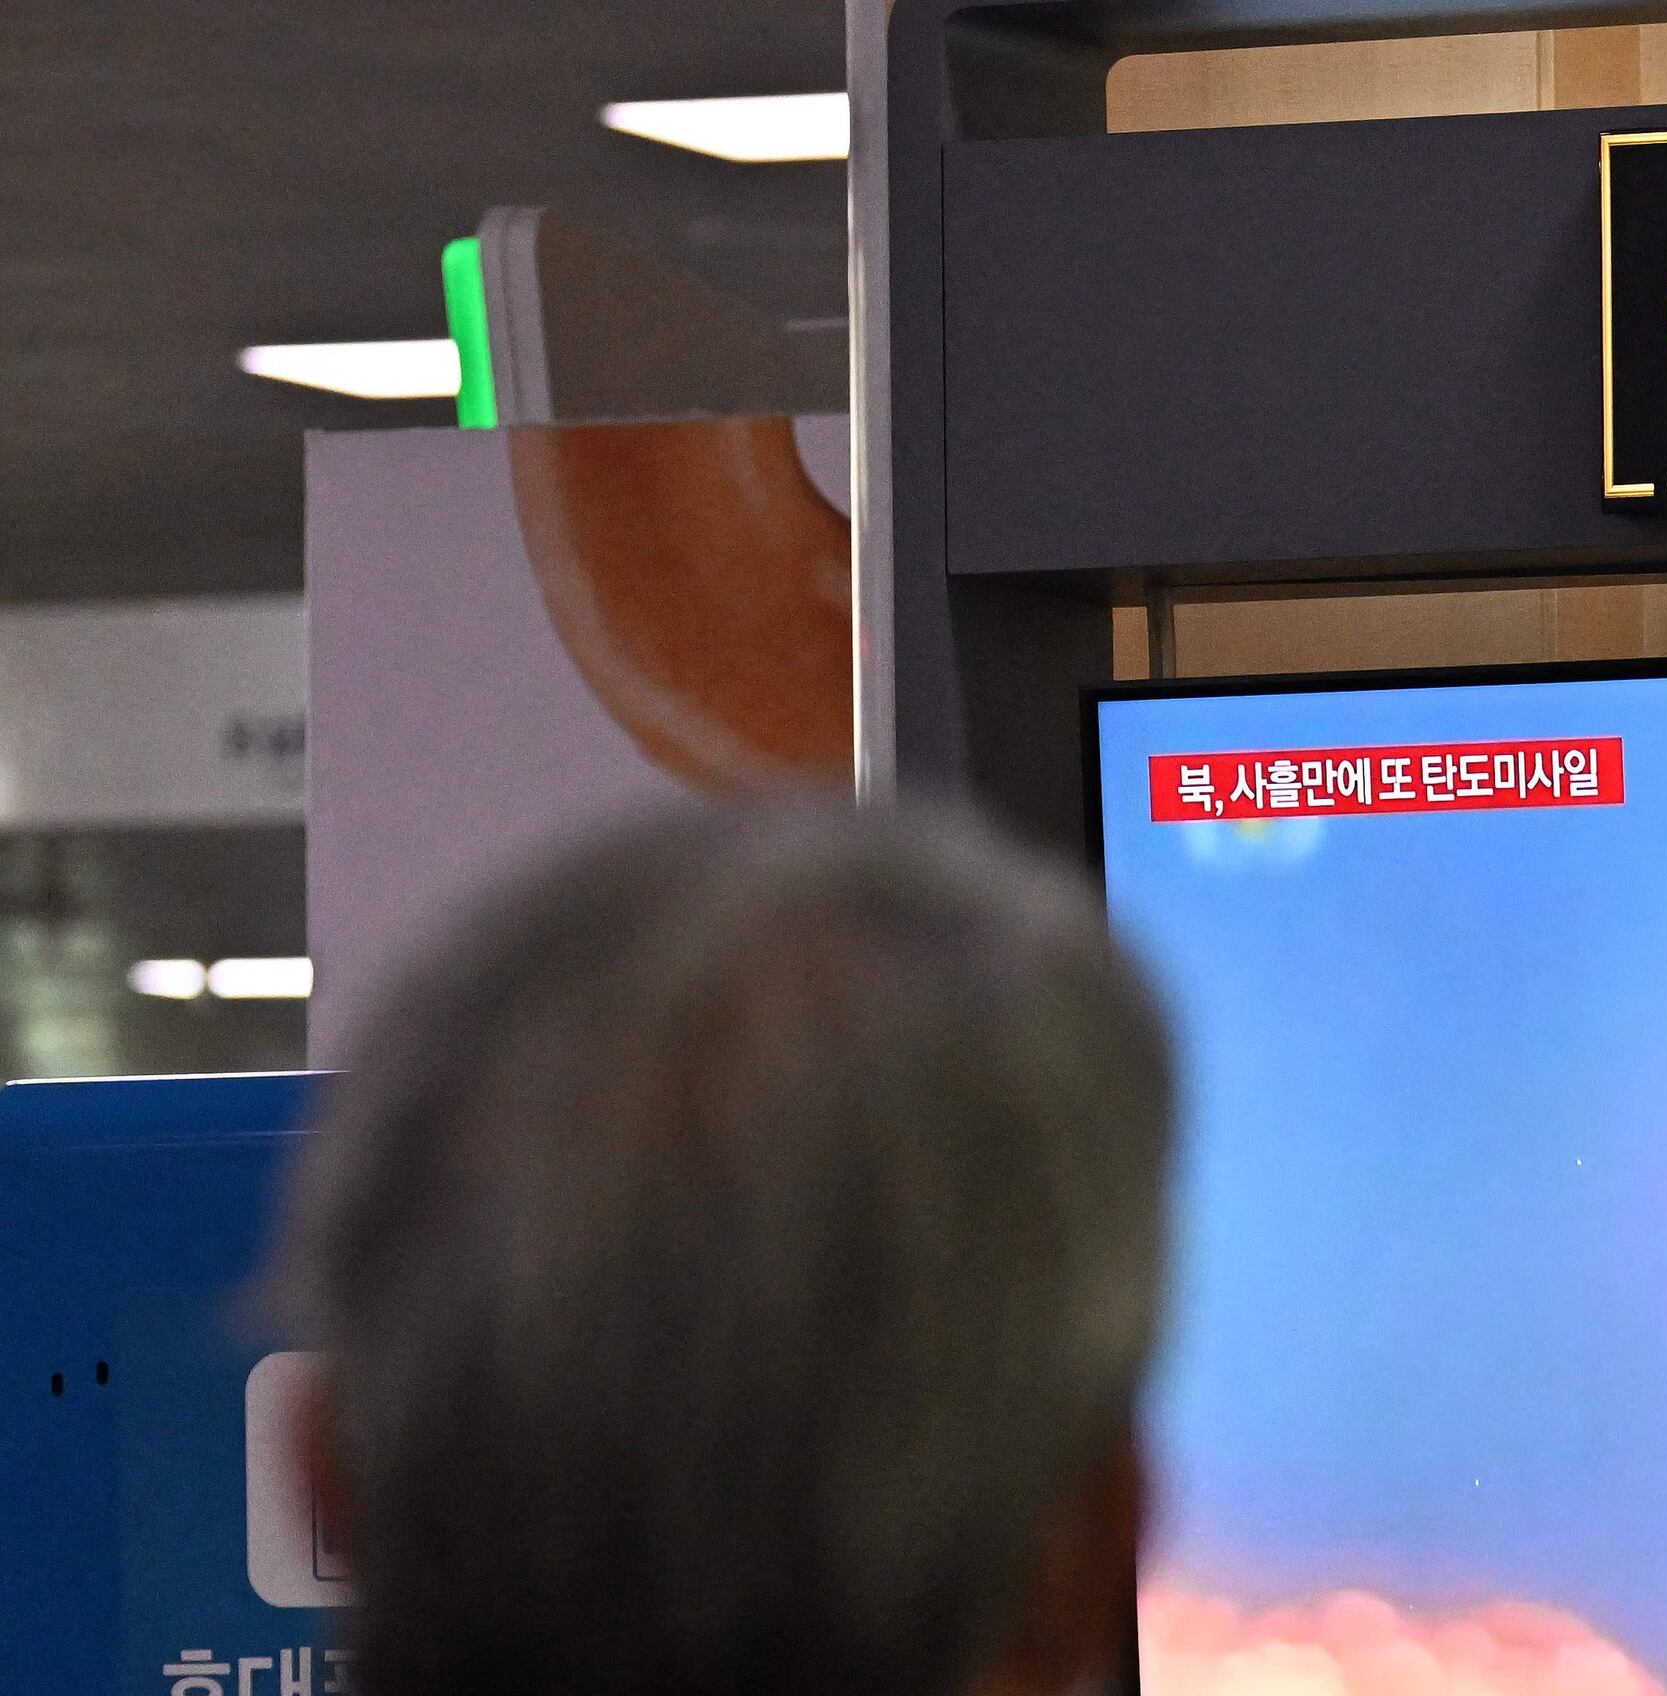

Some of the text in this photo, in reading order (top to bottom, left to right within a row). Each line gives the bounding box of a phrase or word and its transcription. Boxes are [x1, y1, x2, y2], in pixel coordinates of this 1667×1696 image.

[1178, 748, 1599, 817] 북, 사흘만에 또 탄도미사일
